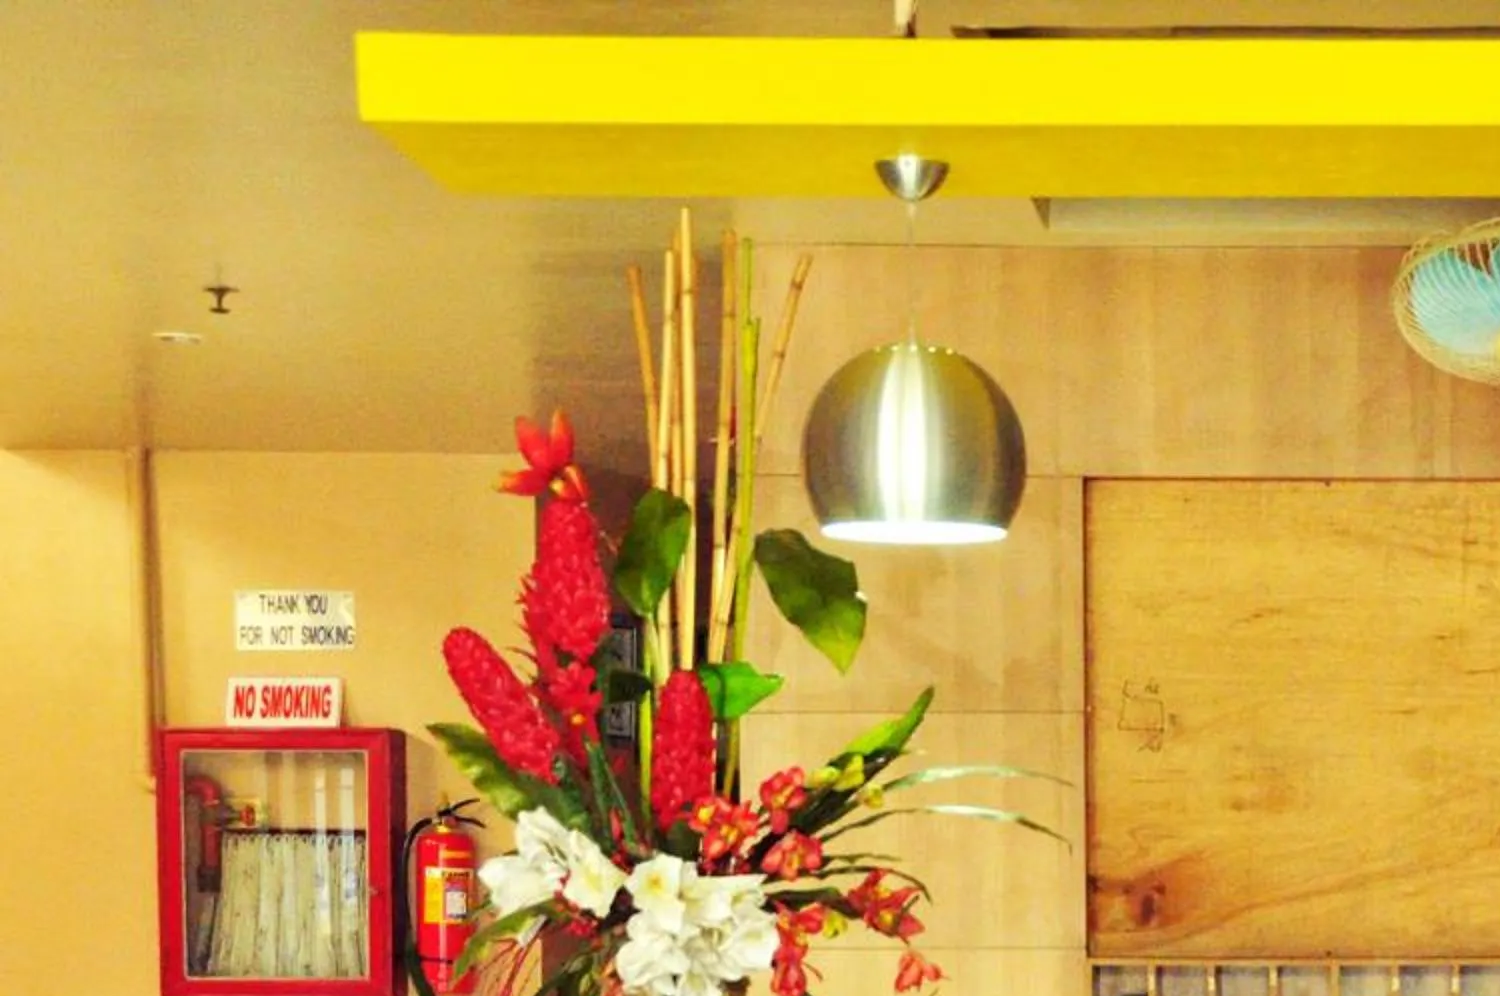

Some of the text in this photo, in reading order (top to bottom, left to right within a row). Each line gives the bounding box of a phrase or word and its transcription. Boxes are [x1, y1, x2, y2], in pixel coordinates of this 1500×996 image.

[260, 594, 329, 615] THANK YOU
[240, 626, 355, 645] FOR NOT SMOKING
[233, 685, 332, 719] NO SMOKING
